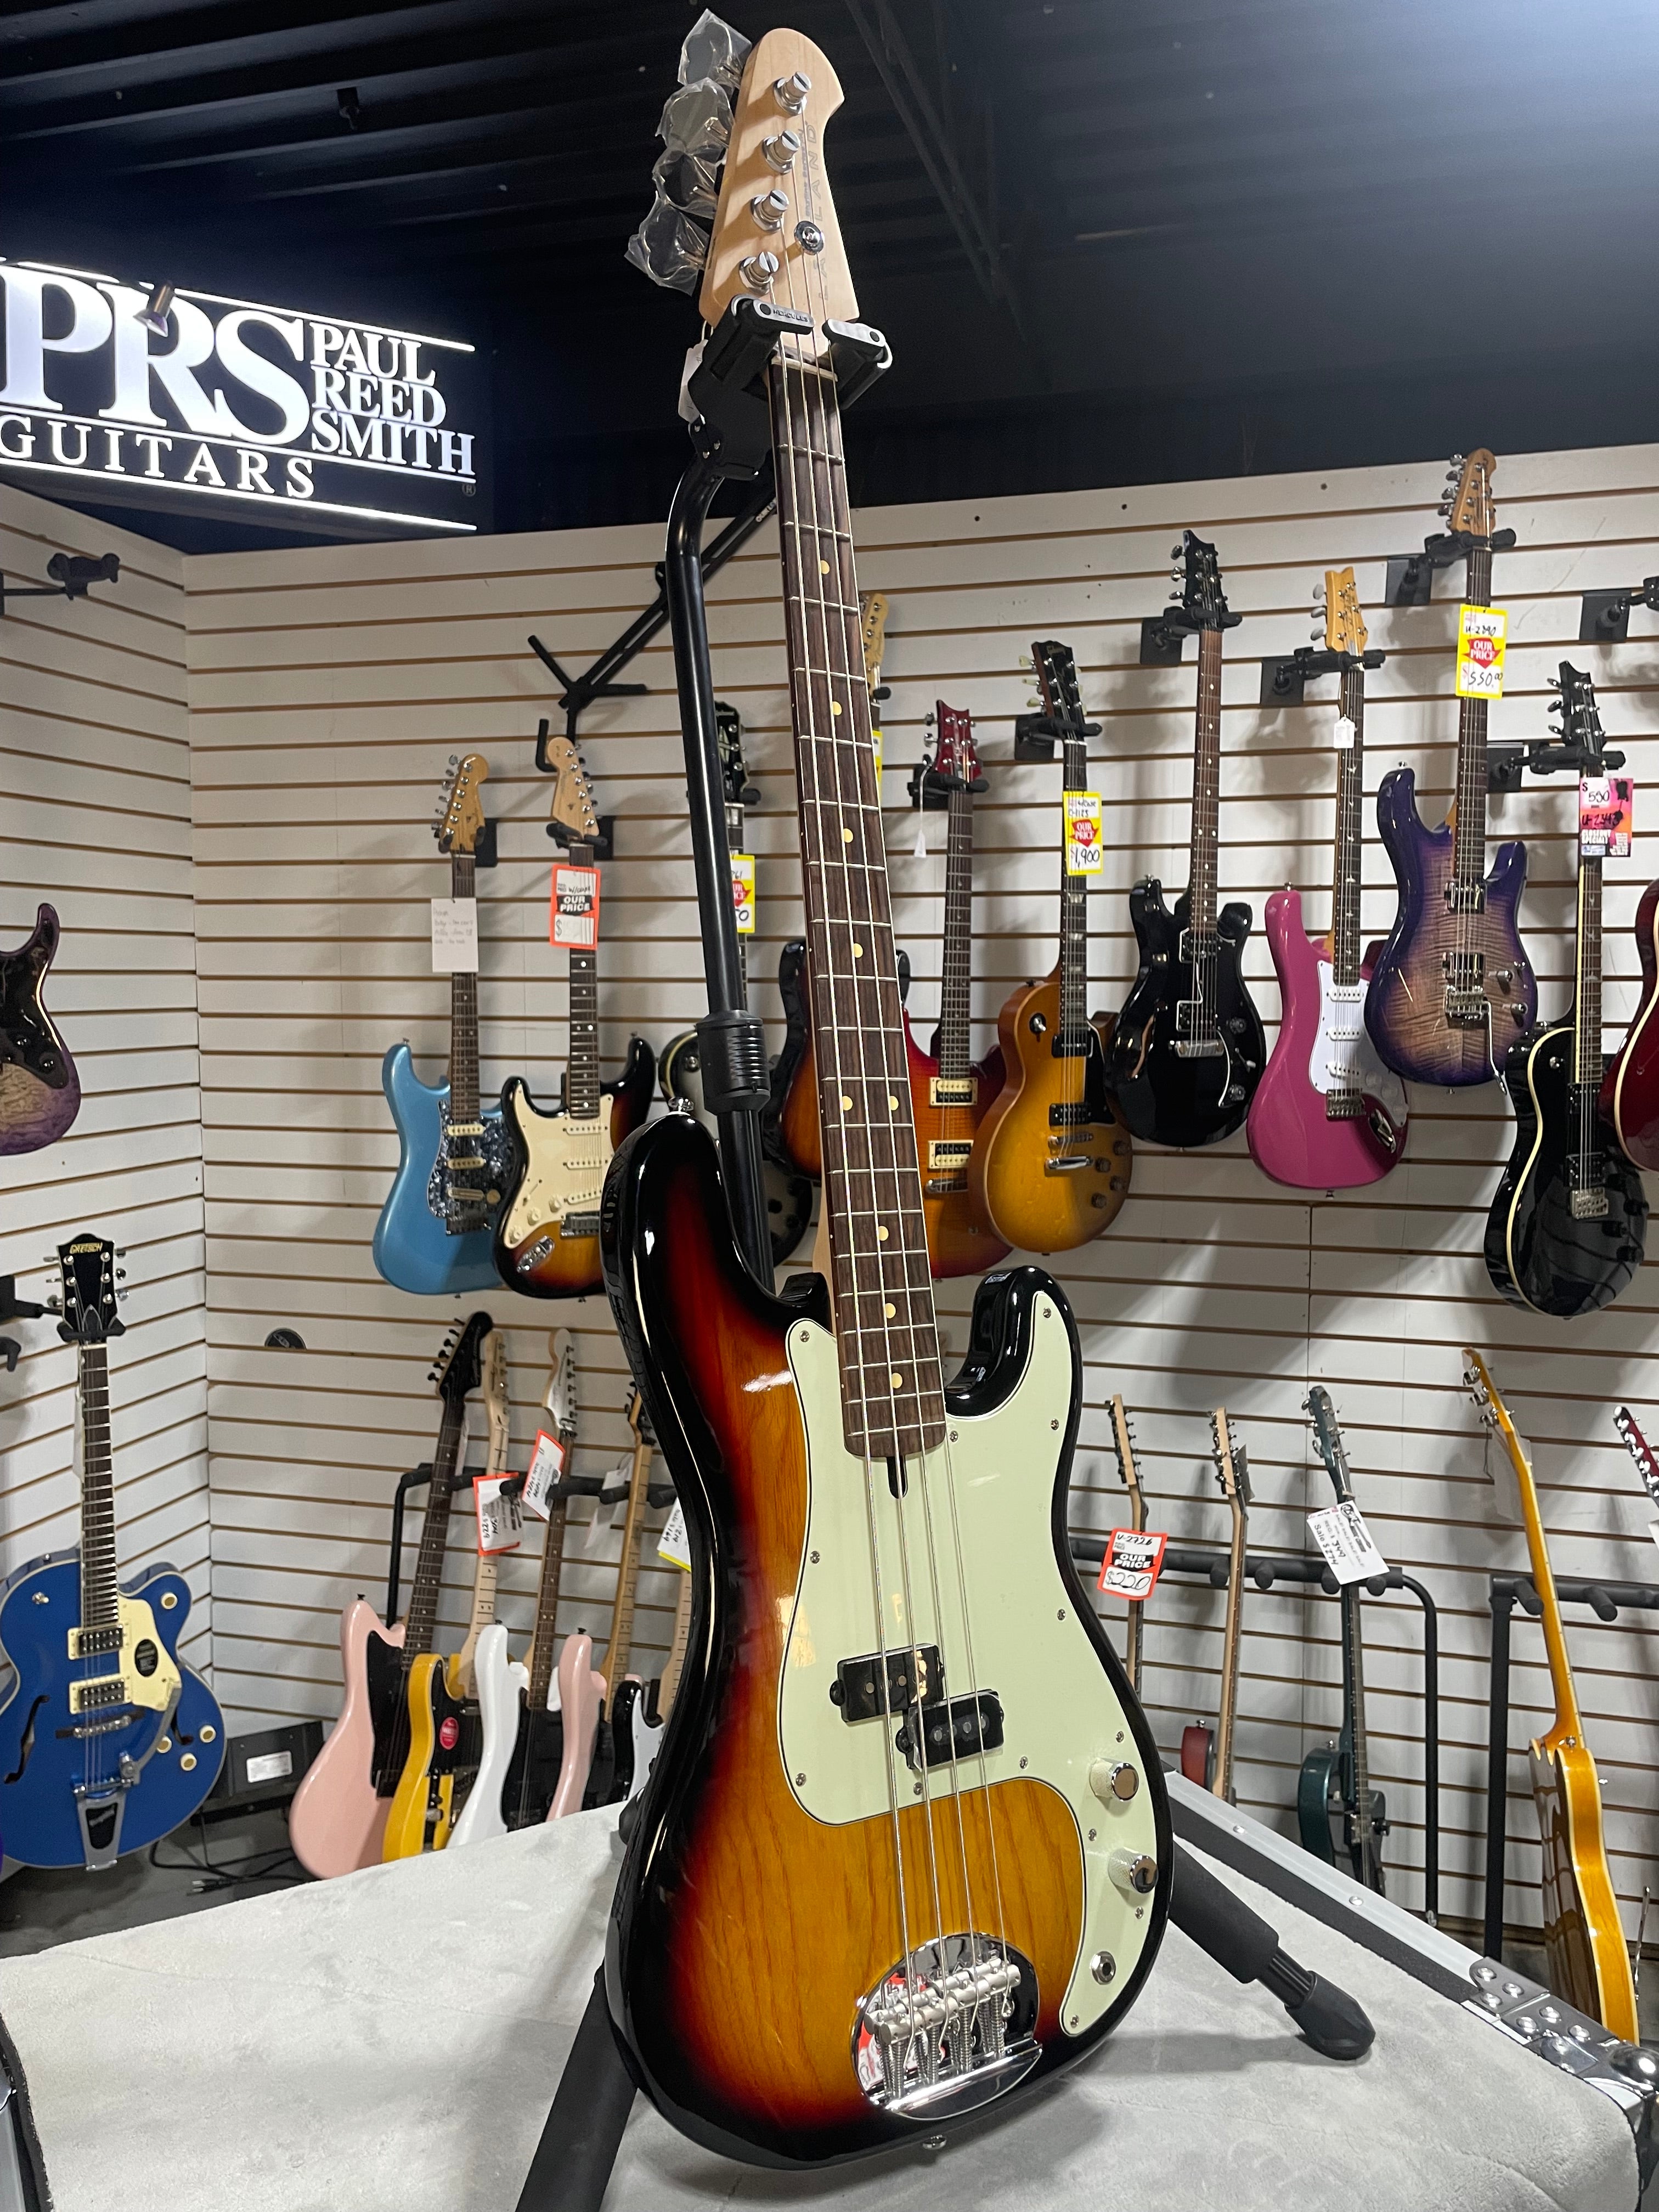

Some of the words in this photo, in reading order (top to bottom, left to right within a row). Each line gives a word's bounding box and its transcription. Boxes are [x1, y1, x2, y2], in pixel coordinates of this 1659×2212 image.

[806, 123, 829, 301] LALAND
[0, 264, 311, 445] PRS
[310, 321, 437, 387] PAUL
[311, 365, 447, 428] REED
[311, 410, 476, 476] SMITH
[0, 414, 315, 499] GUITARS
[1474, 640, 1493, 651] OUR
[1470, 649, 1496, 661] PRICE
[1076, 822, 1092, 832] OUR
[1075, 831, 1094, 840] PRICE
[563, 896, 585, 904] OUR
[560, 903, 590, 912] PRICE
[555, 918, 562, 938] $
[1120, 1553, 1147, 1562] OUR
[1114, 1559, 1152, 1569] PRICE
